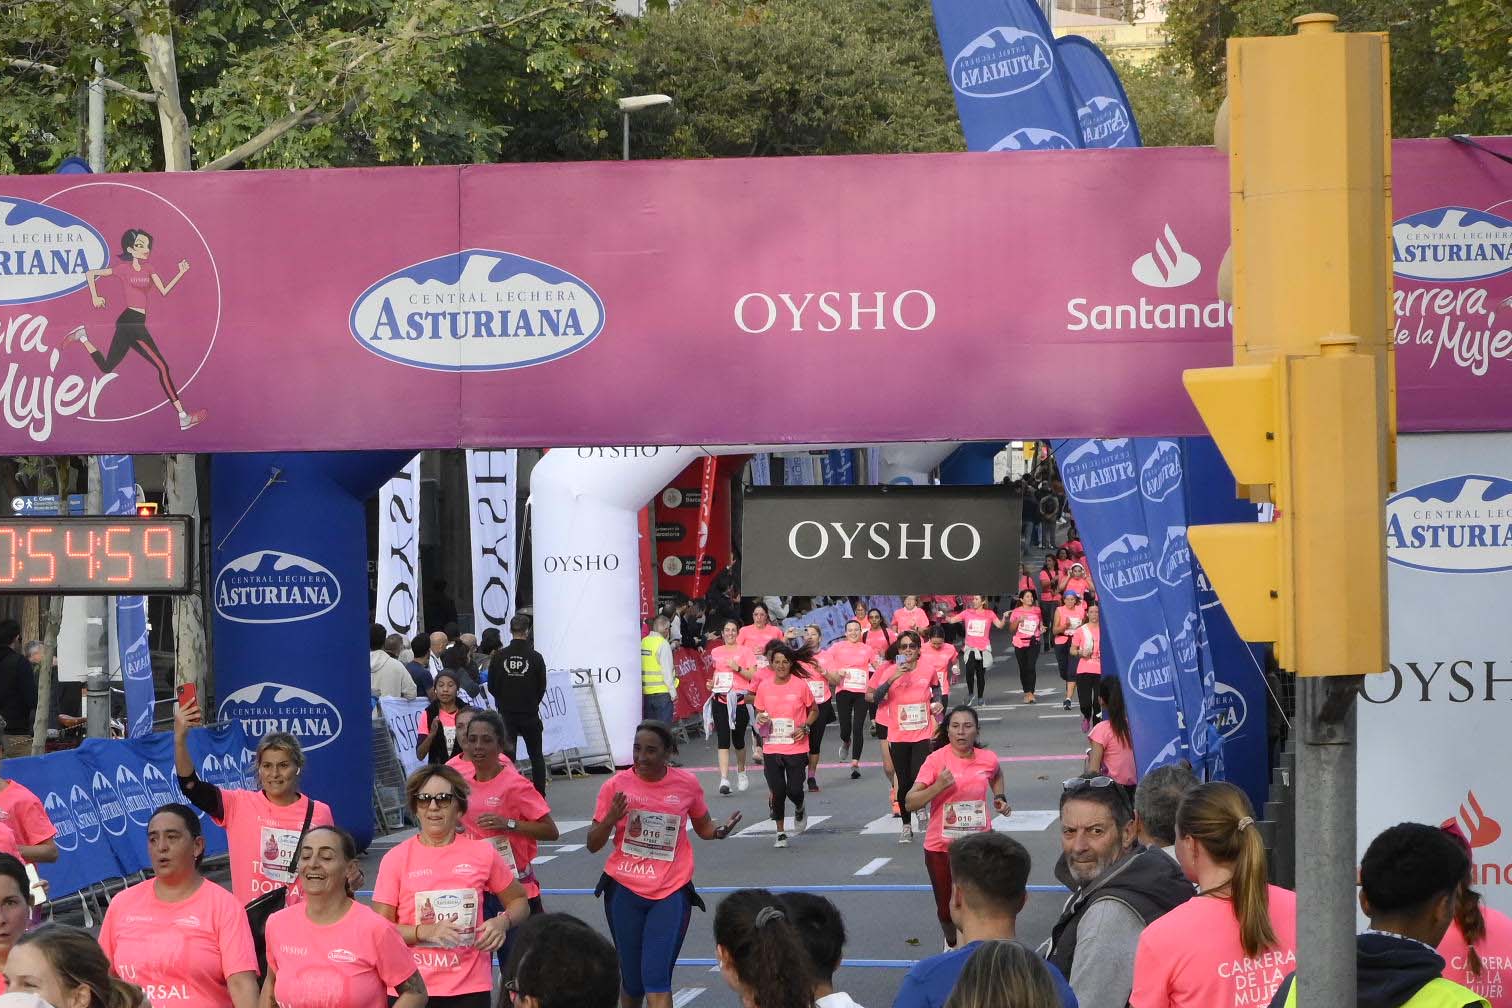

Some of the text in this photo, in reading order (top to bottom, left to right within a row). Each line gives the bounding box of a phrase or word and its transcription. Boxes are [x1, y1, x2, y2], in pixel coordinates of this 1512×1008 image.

[12, 232, 84, 243] LECHERA
[409, 290, 576, 304] CENTRAL LECHERA
[1393, 287, 1487, 316] arrera
[370, 297, 585, 341] ASTURIANA
[735, 290, 935, 333] OYSHO
[1067, 297, 1234, 331] Santand
[1416, 318, 1433, 344] la
[1430, 312, 1512, 376] Muje
[1414, 510, 1480, 519] CENTRAL
[788, 521, 981, 561] OYSHO
[1387, 513, 1512, 549] ASTURIA
[544, 553, 619, 574] OYSHO
[231, 575, 327, 584] CENTRAL LECHERA
[218, 579, 331, 607] ASTURIANA
[509, 660, 523, 671] BP
[572, 666, 621, 686] SHO
[1358, 660, 1512, 704] OYSH
[233, 707, 327, 716] CENTRAL LECHERA
[643, 829, 660, 838] 016
[280, 850, 293, 858] 01
[414, 953, 460, 967] SUMA
[1218, 950, 1296, 978] CARRERA
[119, 965, 136, 978] TU
[1235, 968, 1284, 990] DE LA
[1488, 970, 1502, 984] LA
[1235, 985, 1278, 1007] MUJE
